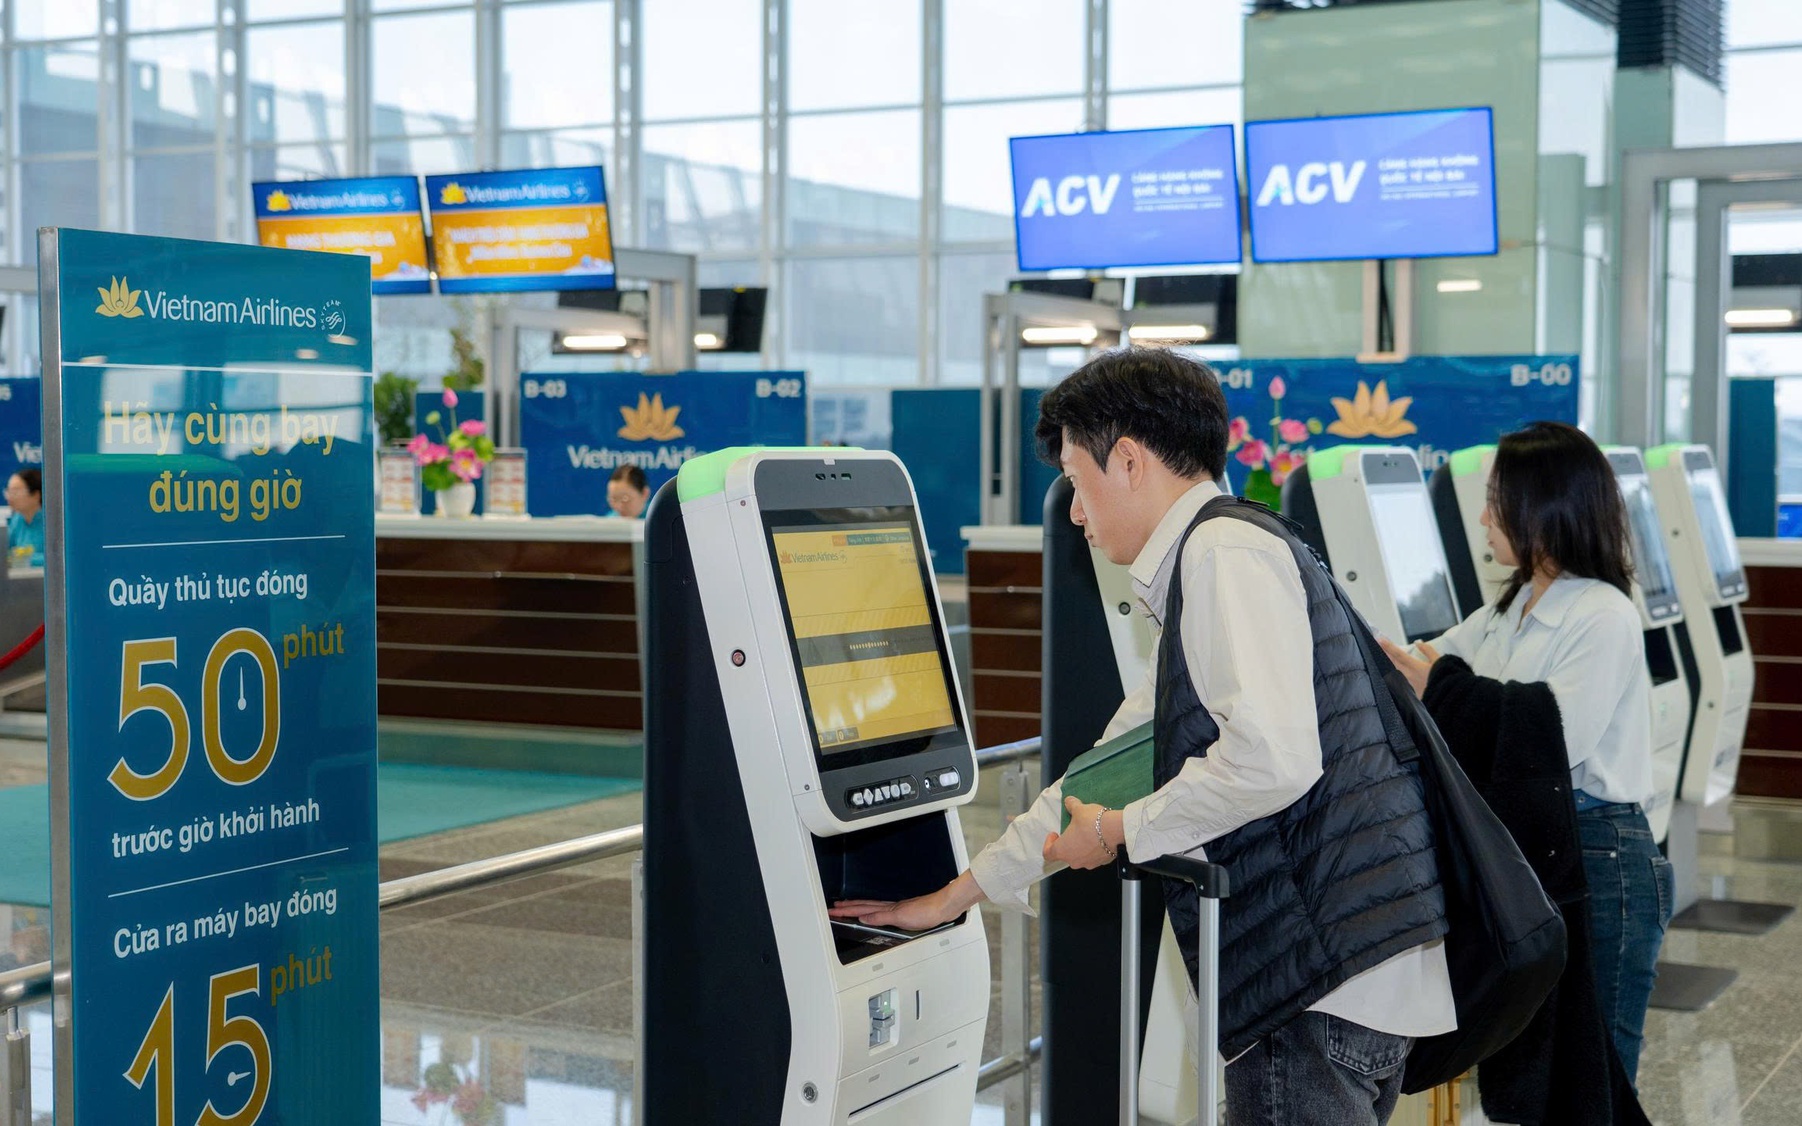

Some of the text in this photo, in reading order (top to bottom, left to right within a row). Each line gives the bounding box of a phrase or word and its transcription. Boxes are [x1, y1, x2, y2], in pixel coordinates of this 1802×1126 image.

[1021, 173, 1121, 219] ACV
[1256, 160, 1366, 208] ACV
[144, 290, 317, 328] Vietnam Airlines
[523, 379, 567, 399] B-03
[755, 378, 802, 398] B-02
[1511, 364, 1573, 387] B-00
[103, 400, 174, 456] Hãy
[185, 403, 268, 456] cùng
[281, 404, 339, 456] bay
[149, 469, 303, 523] đúng giờ
[109, 569, 308, 610] Quầy thủ tục đóng
[283, 622, 345, 669] phút
[107, 627, 281, 802] 50
[112, 798, 320, 858] trước giờ khởi hành
[113, 886, 338, 958] Cửa ra máy bay đóng
[270, 947, 333, 1006] phút
[123, 963, 272, 1126] 15
